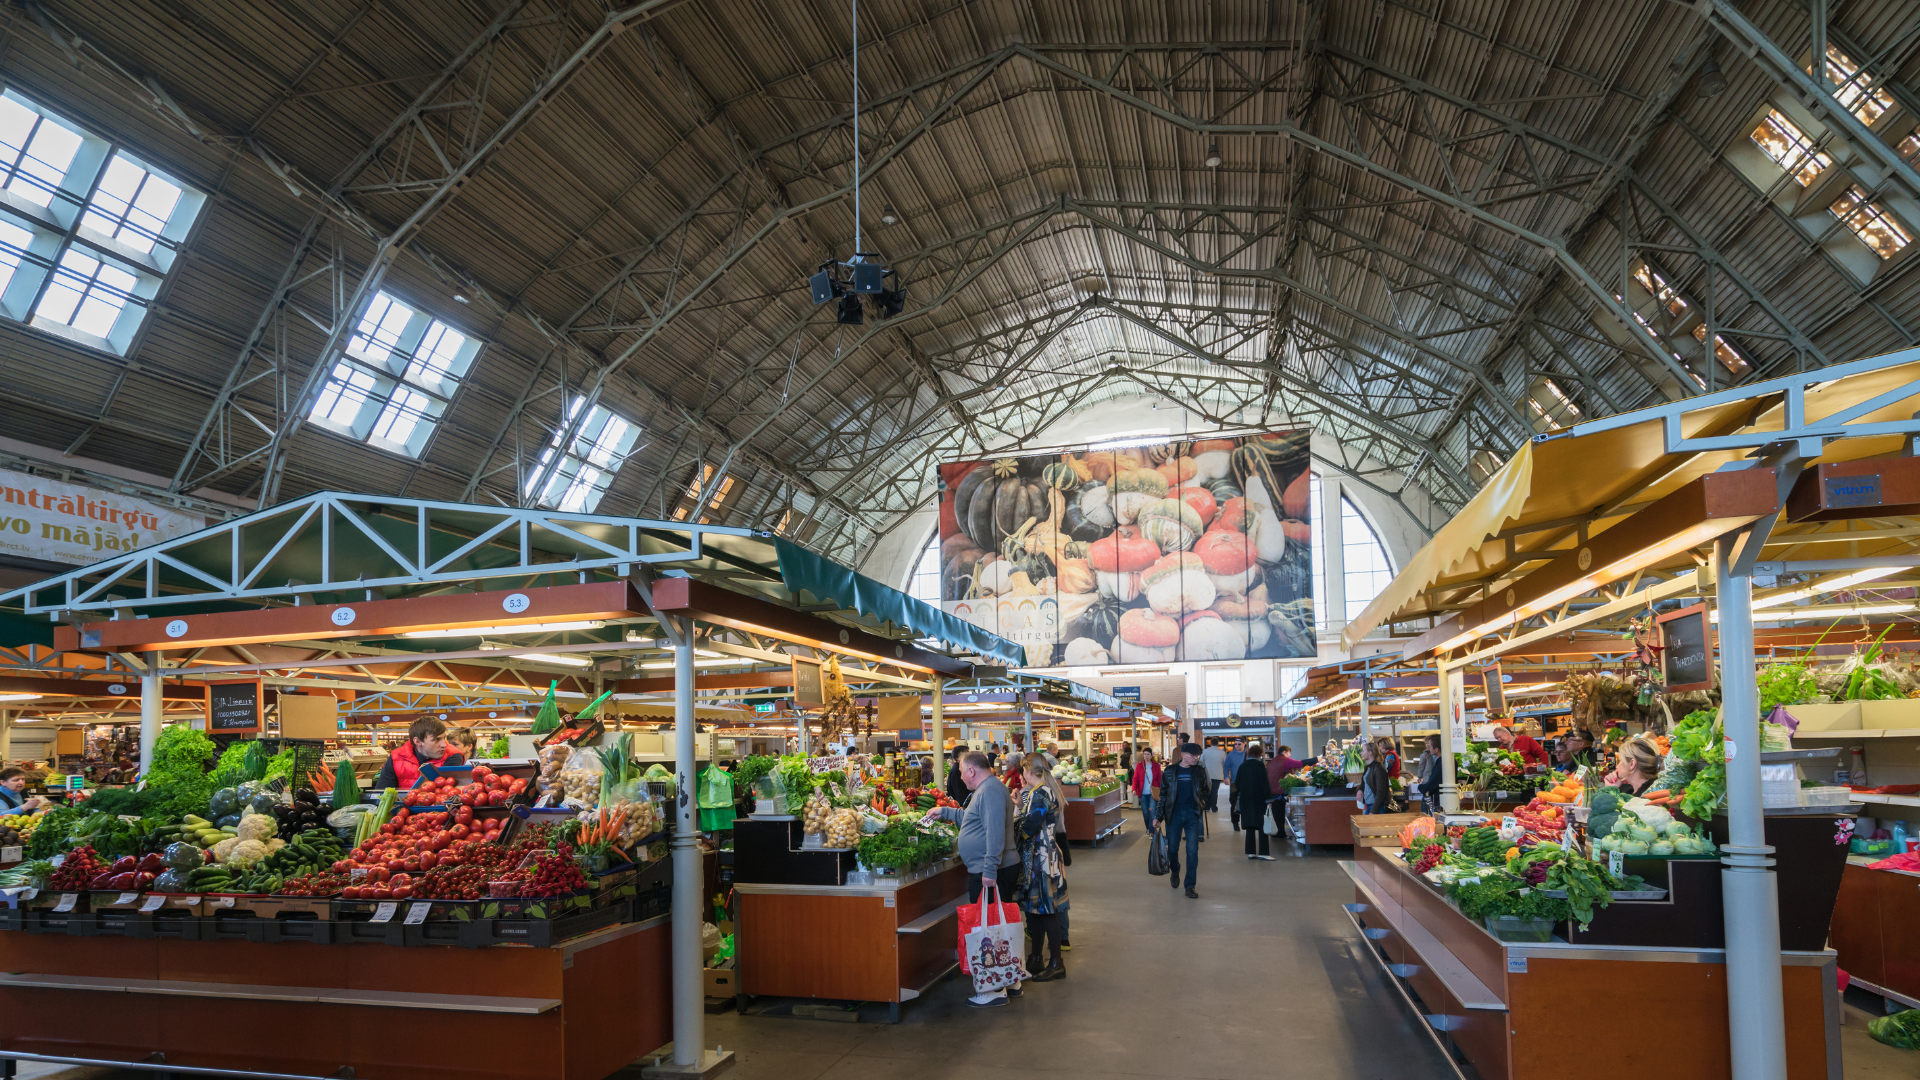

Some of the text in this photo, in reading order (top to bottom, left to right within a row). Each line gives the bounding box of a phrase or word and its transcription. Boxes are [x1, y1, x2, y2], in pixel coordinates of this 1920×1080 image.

[1833, 485, 1874, 495] vitrum
[509, 598, 524, 608] 5.3.
[337, 611, 351, 621] 5.2.
[171, 624, 183, 633] 5.1.
